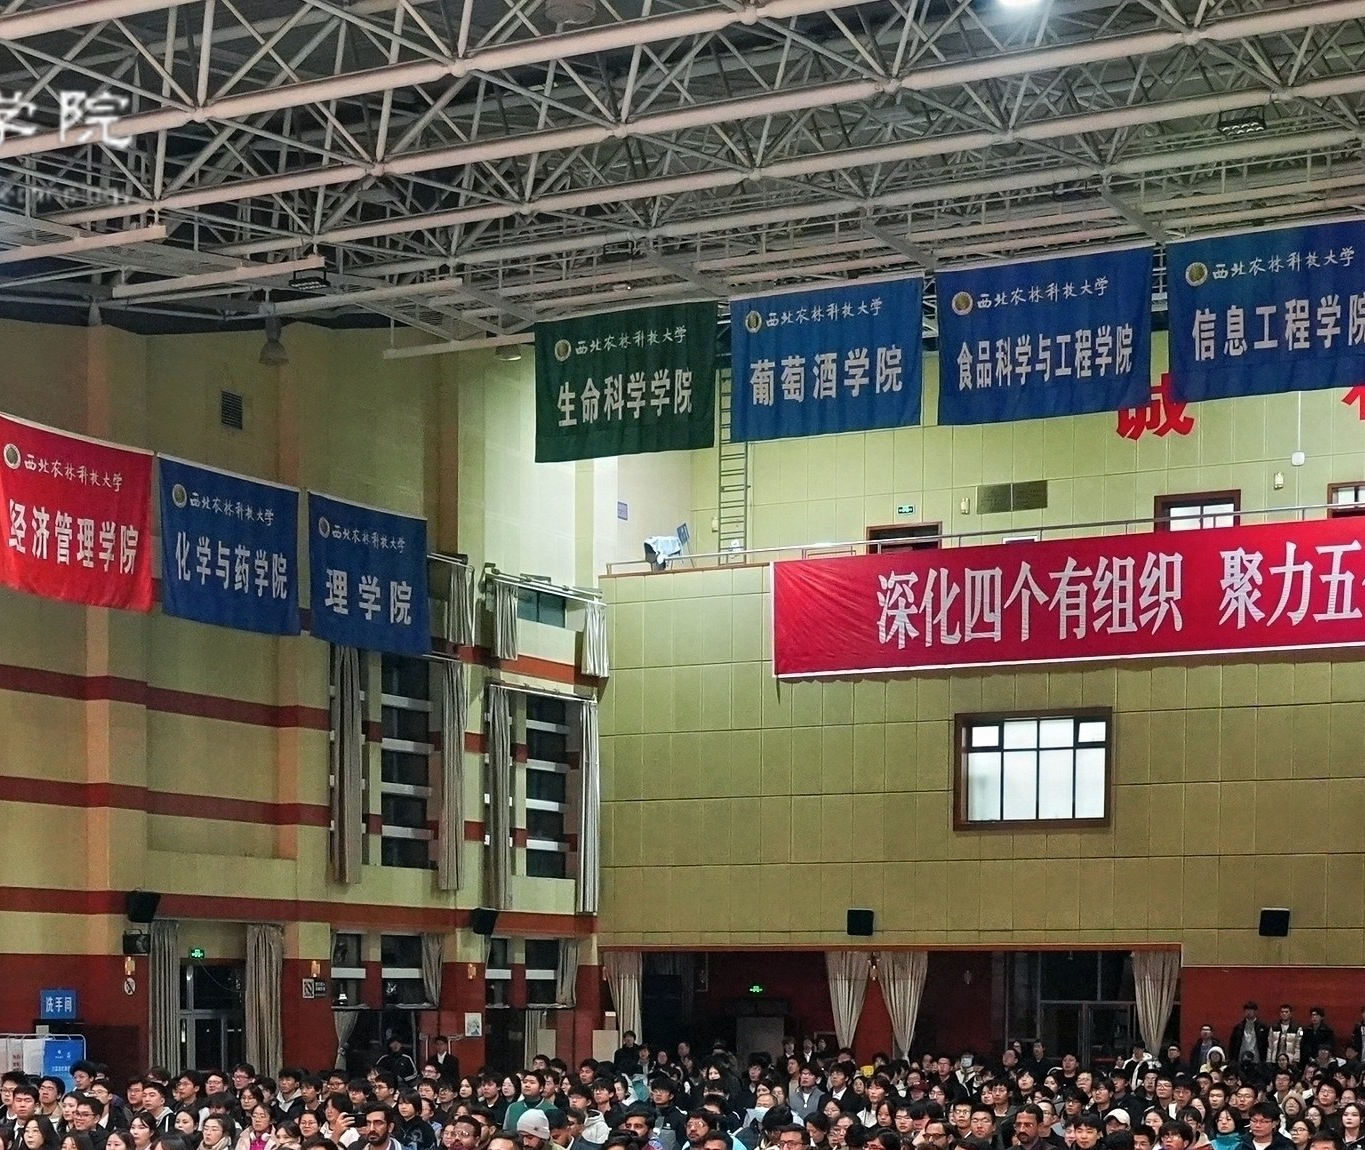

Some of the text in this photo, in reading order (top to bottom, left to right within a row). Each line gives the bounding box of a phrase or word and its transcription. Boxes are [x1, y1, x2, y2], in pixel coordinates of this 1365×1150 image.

[1212, 245, 1356, 280] 西北农林科技大学
[765, 296, 883, 329] 西北农林科技大学
[976, 276, 1110, 311] 西北农林科技大学
[574, 324, 688, 357] 西北农林科技大学
[956, 322, 1134, 392] 食品科学与工程学院
[557, 368, 694, 428] 生命科学学院
[749, 345, 903, 407] 葡萄酒学院
[23, 454, 123, 494] 西北农林科技大学
[188, 491, 274, 527] 西北农林科技大学
[8, 500, 139, 576] 经济管理学院
[330, 522, 406, 555] 西北农林科技大学
[175, 532, 288, 600] 化学与药学院
[325, 568, 413, 626] 理学院
[876, 551, 1184, 650] 深化四个有组织
